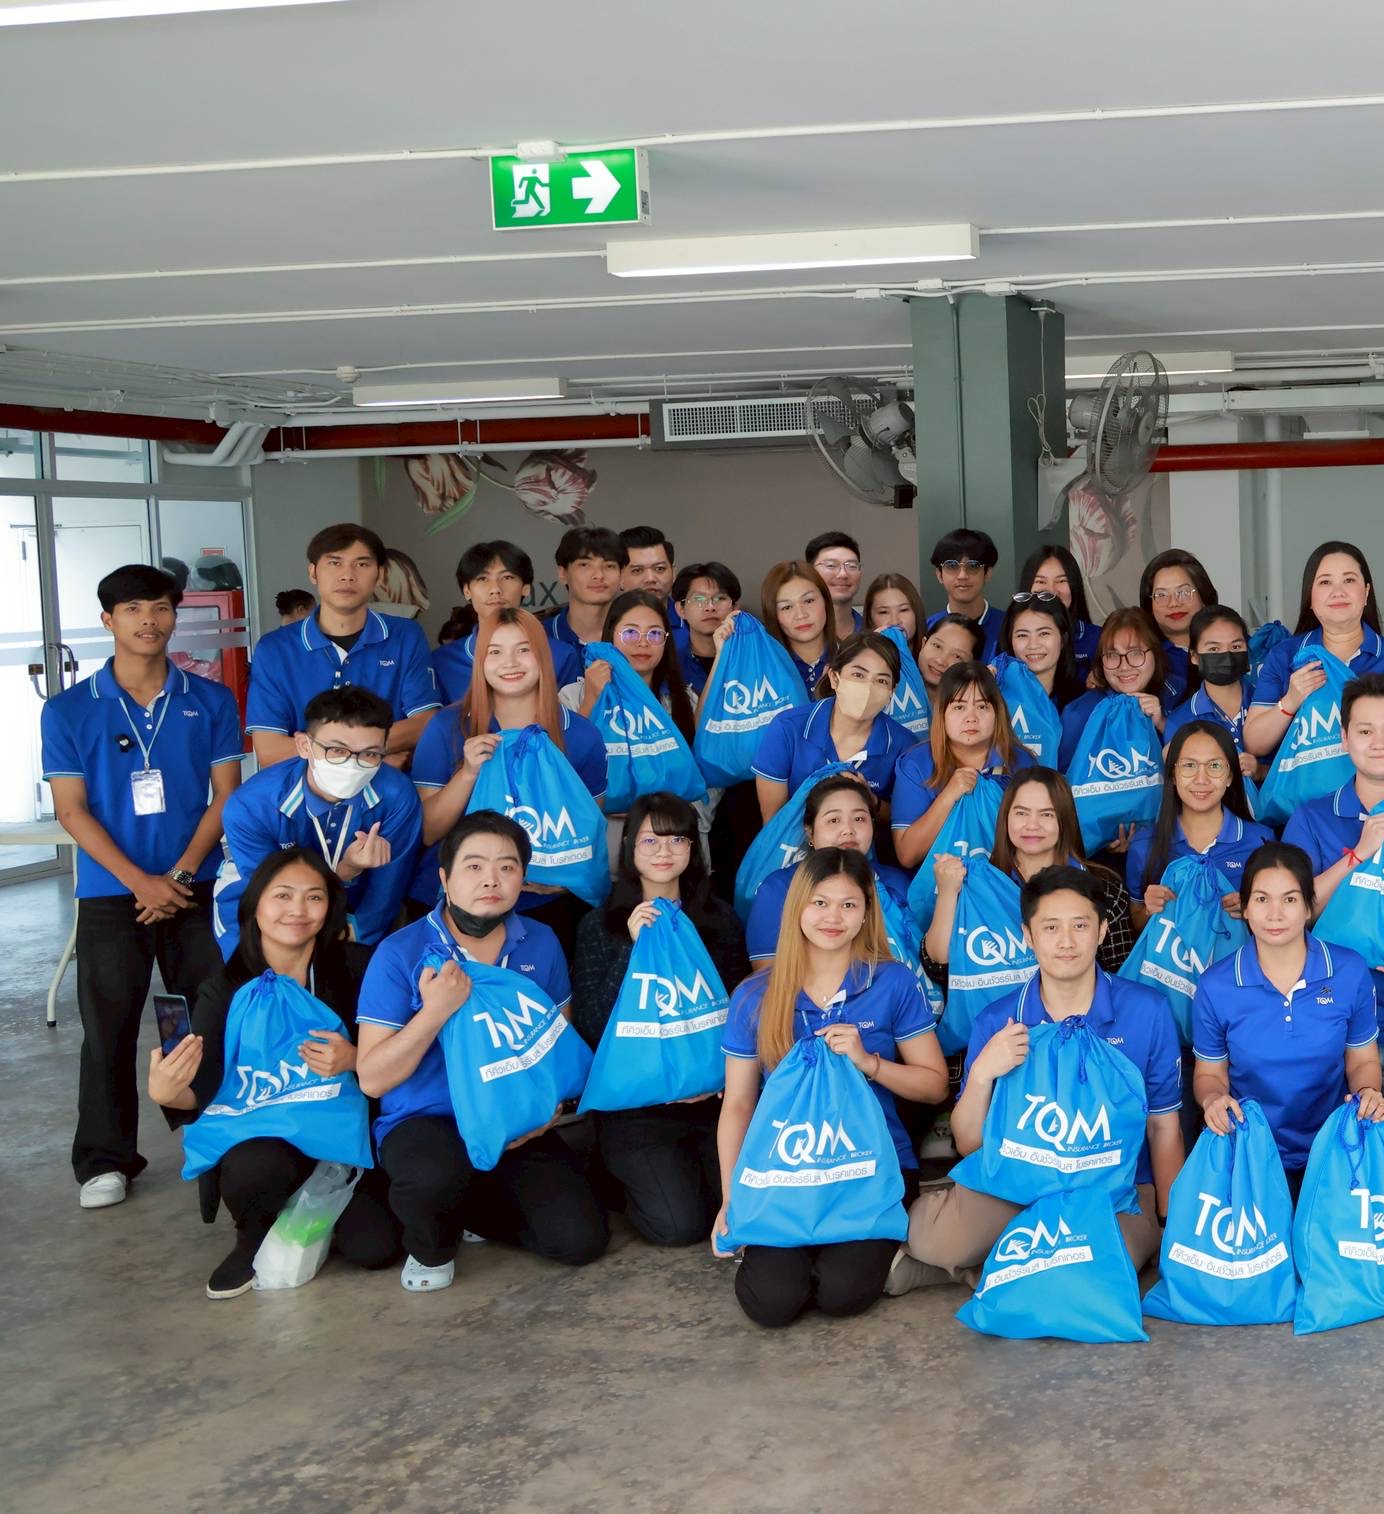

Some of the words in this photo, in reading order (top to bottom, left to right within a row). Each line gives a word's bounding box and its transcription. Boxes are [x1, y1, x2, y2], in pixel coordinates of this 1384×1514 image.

[723, 674, 779, 715] QM
[958, 925, 1034, 966] QM
[631, 969, 714, 1018] TQM
[1316, 997, 1334, 1005] TQM
[857, 1021, 875, 1029] TQM
[1106, 1037, 1124, 1045] TQM
[768, 1119, 856, 1166] TQM
[1016, 1093, 1111, 1151] TQM
[1066, 1143, 1100, 1153] INSURANCE
[994, 1215, 1072, 1262] QM
